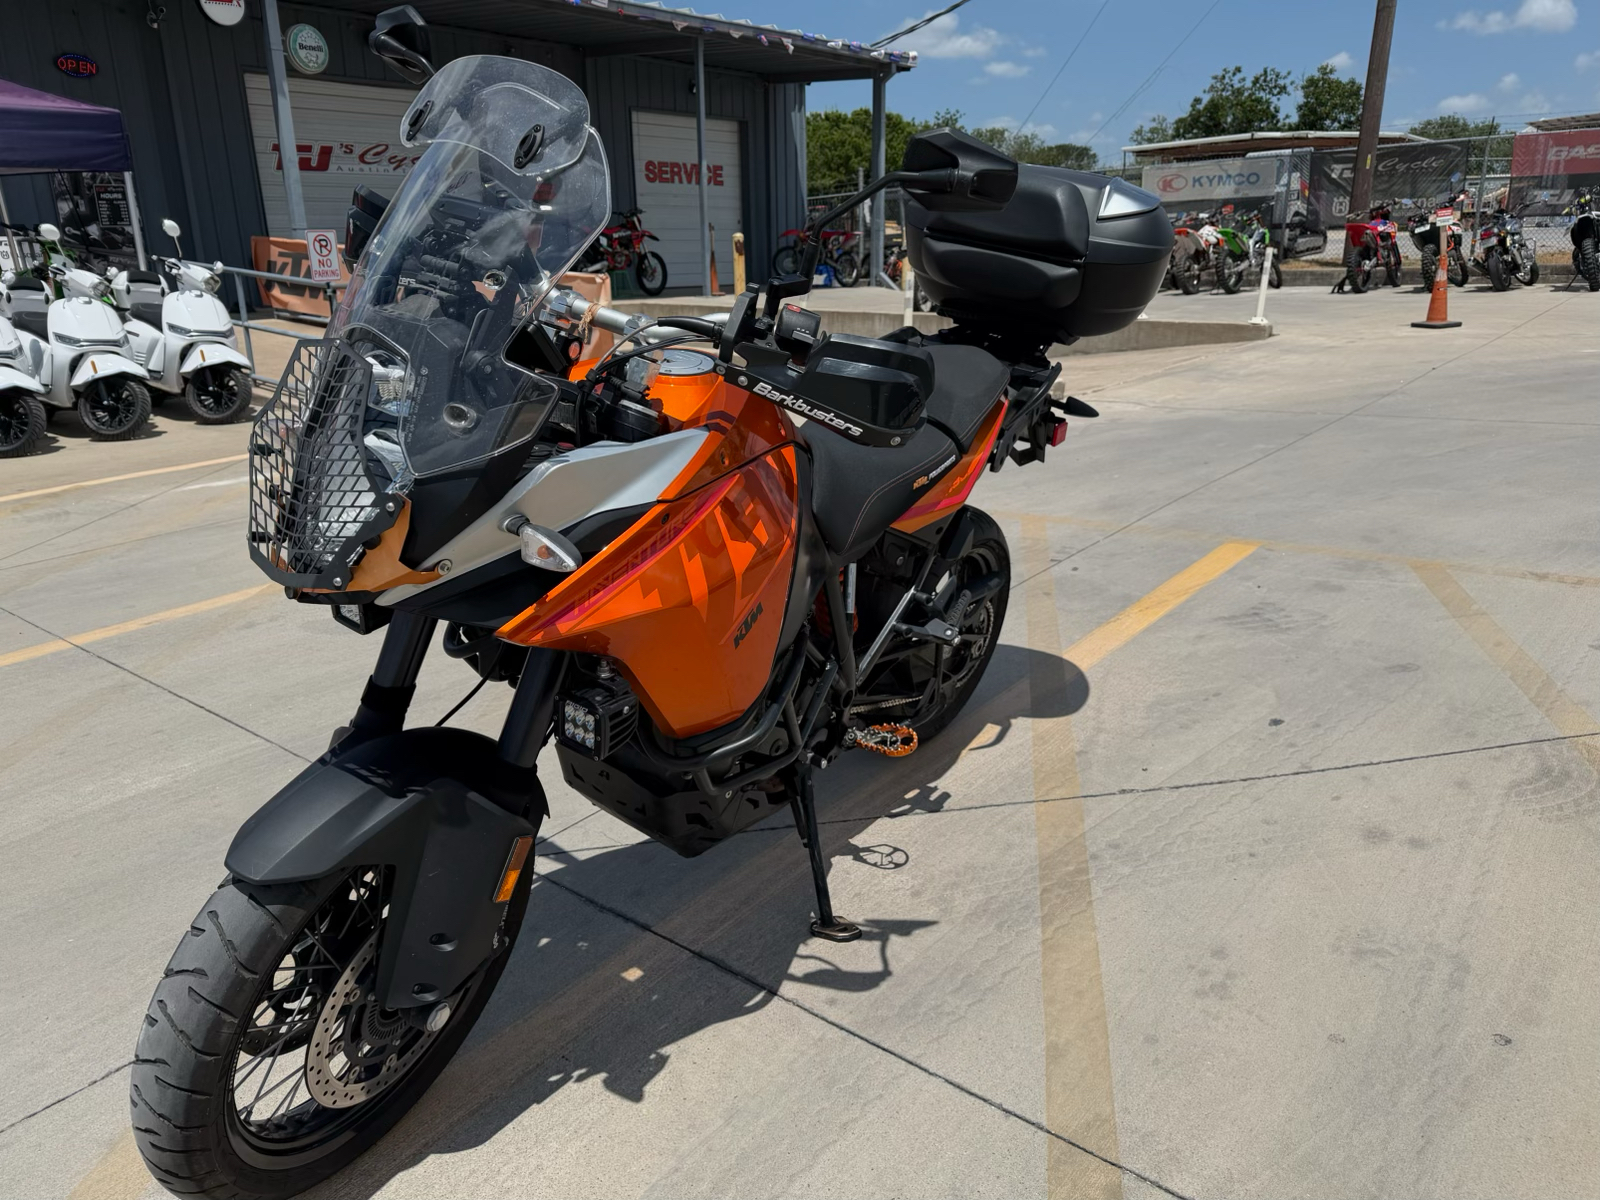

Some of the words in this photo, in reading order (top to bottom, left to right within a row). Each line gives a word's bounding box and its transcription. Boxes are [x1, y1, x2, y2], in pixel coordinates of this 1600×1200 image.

[298, 42, 324, 53] Benelli
[57, 57, 96, 74] OPEN
[1377, 157, 1445, 172] Cycle
[1192, 172, 1260, 188] KYMCO
[318, 258, 332, 268] NO
[314, 269, 340, 278] PARKING
[753, 382, 863, 436] Barkbusters
[733, 601, 764, 650] KTM
